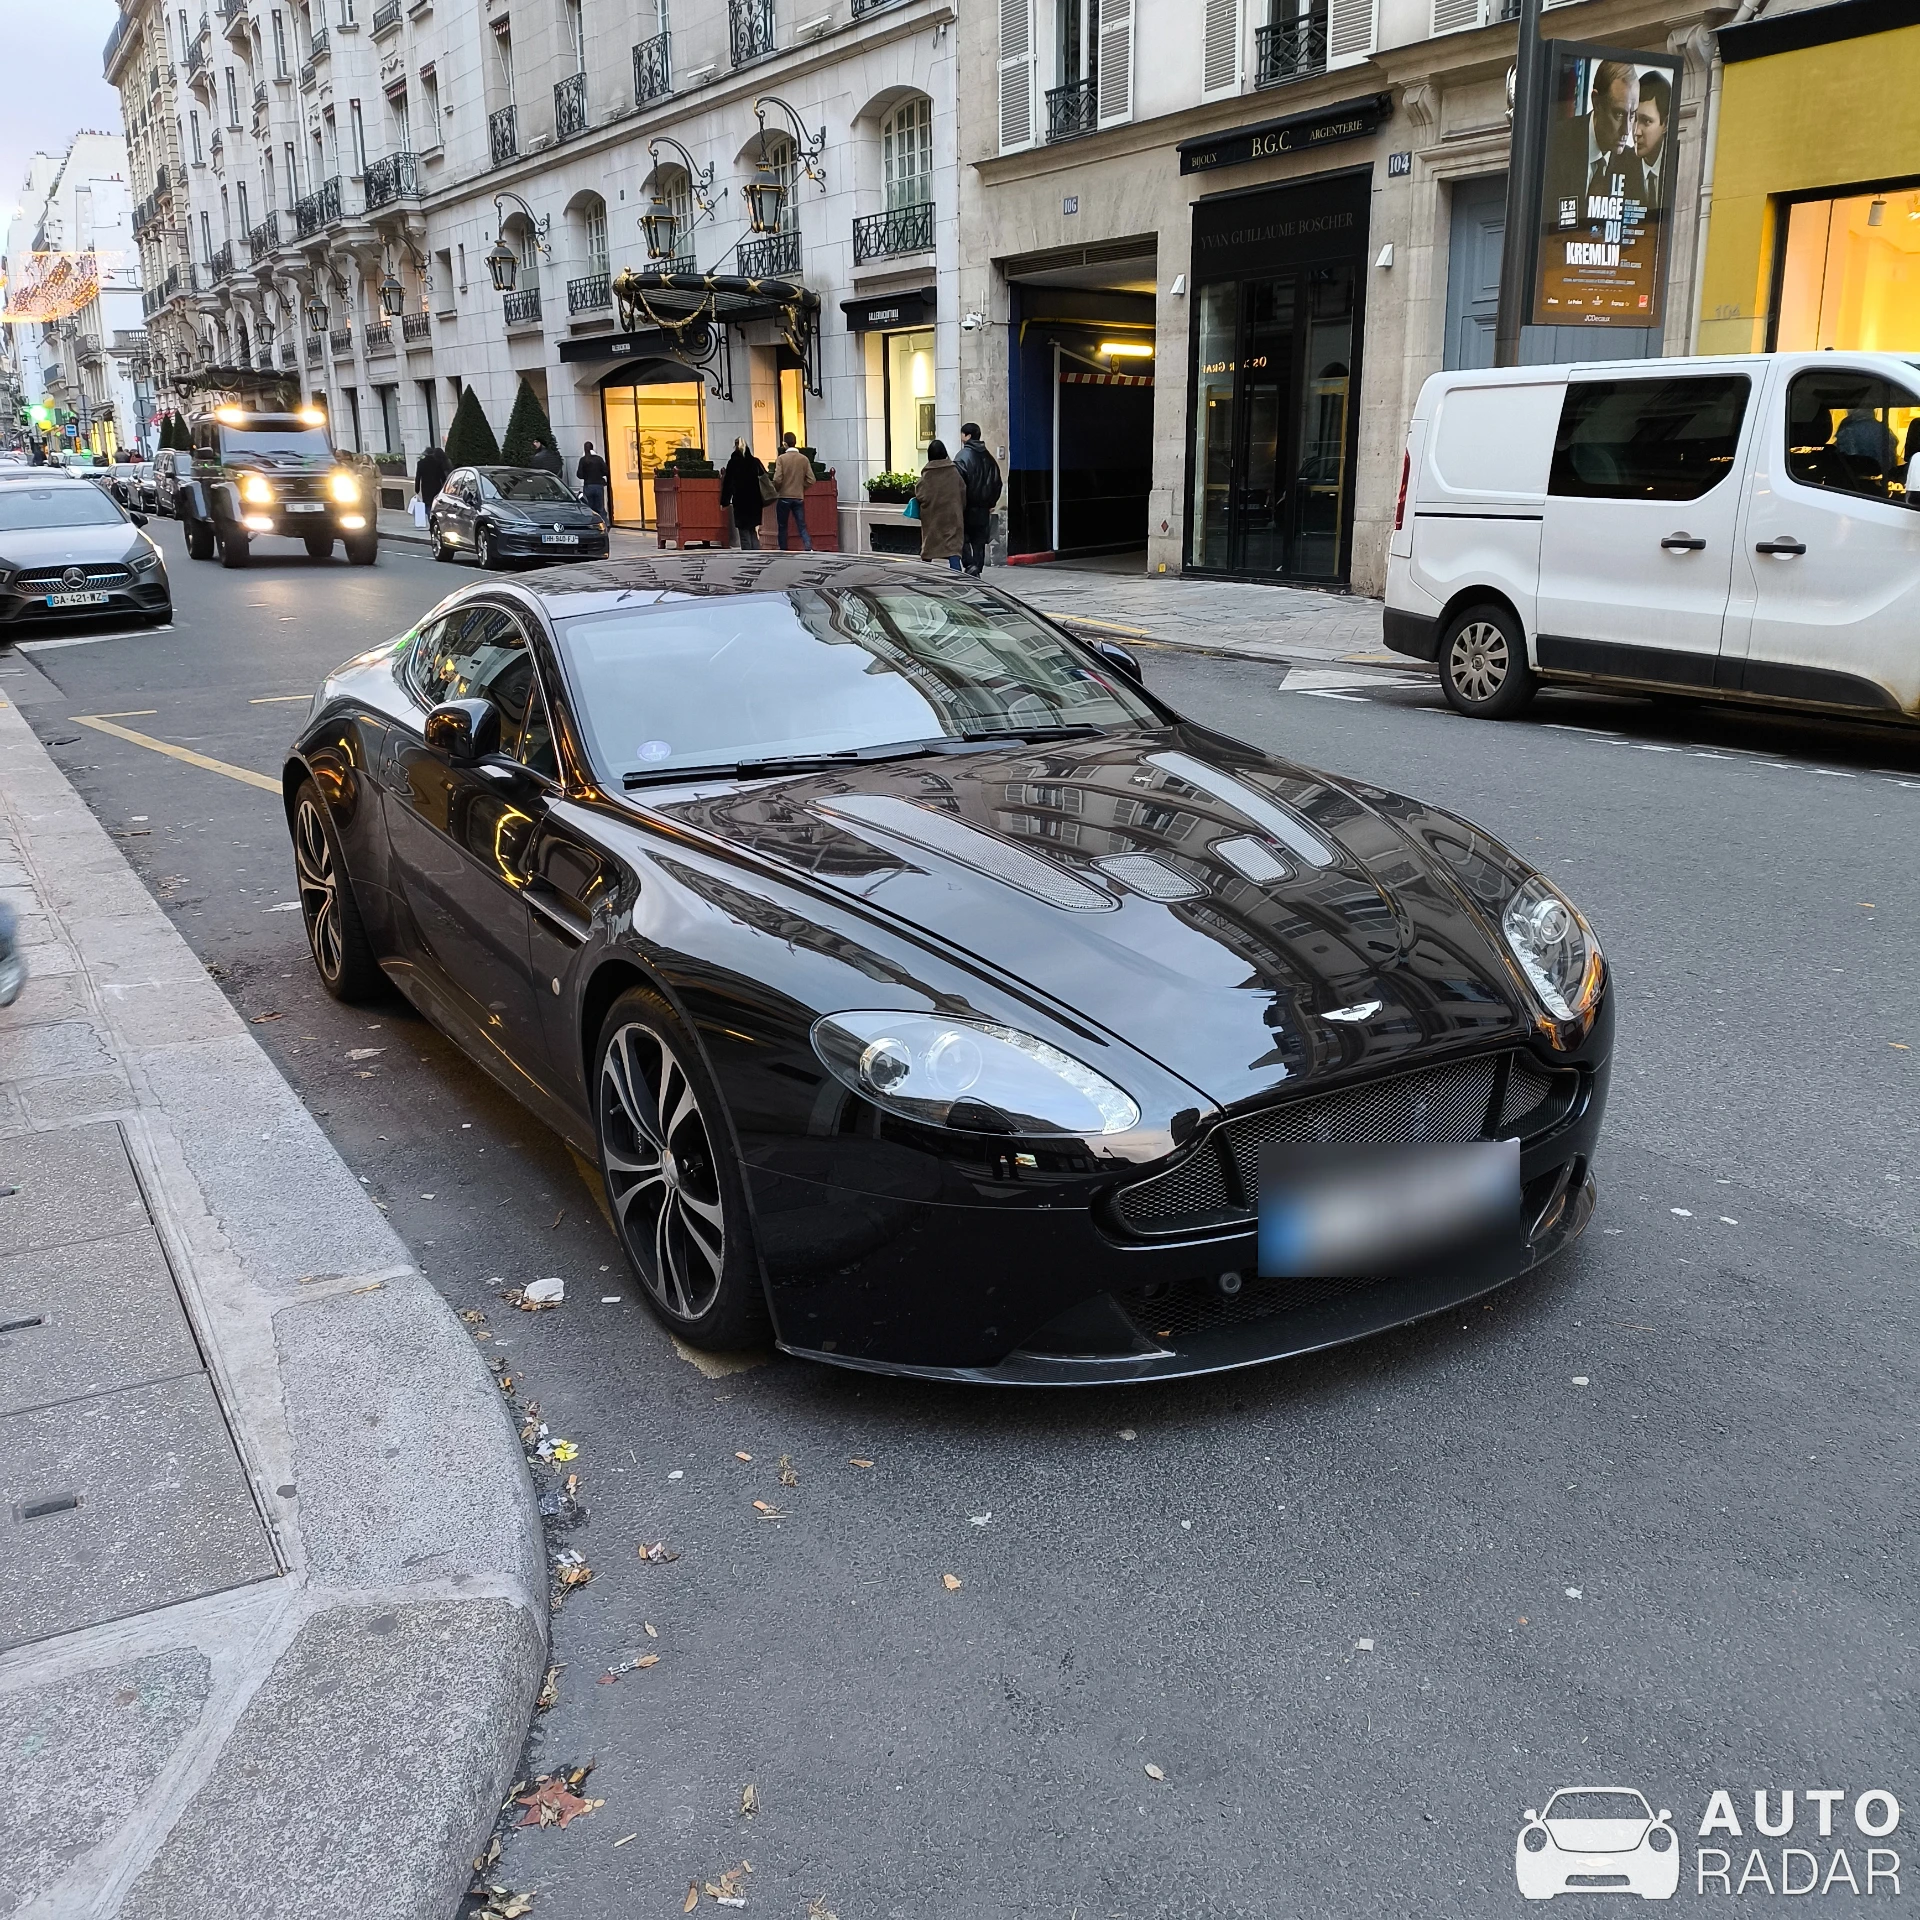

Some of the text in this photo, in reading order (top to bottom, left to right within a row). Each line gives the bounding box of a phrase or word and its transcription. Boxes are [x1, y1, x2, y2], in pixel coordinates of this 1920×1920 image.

[1191, 119, 1363, 168] BIJOUX B.G.C. ARGENTERIE
[1389, 154, 1410, 174] 104
[1611, 173, 1625, 197] LE
[1064, 198, 1077, 214] 106
[1560, 199, 1576, 211] LE 21
[1587, 195, 1624, 220] MAGE
[1200, 212, 1354, 250] YVAN GUILLAUME BOSCHER
[1604, 220, 1621, 243] DU
[1566, 241, 1620, 266] KREMLIN
[1584, 314, 1611, 322] JCDecaux
[52, 592, 102, 605] GA-421-WZ
